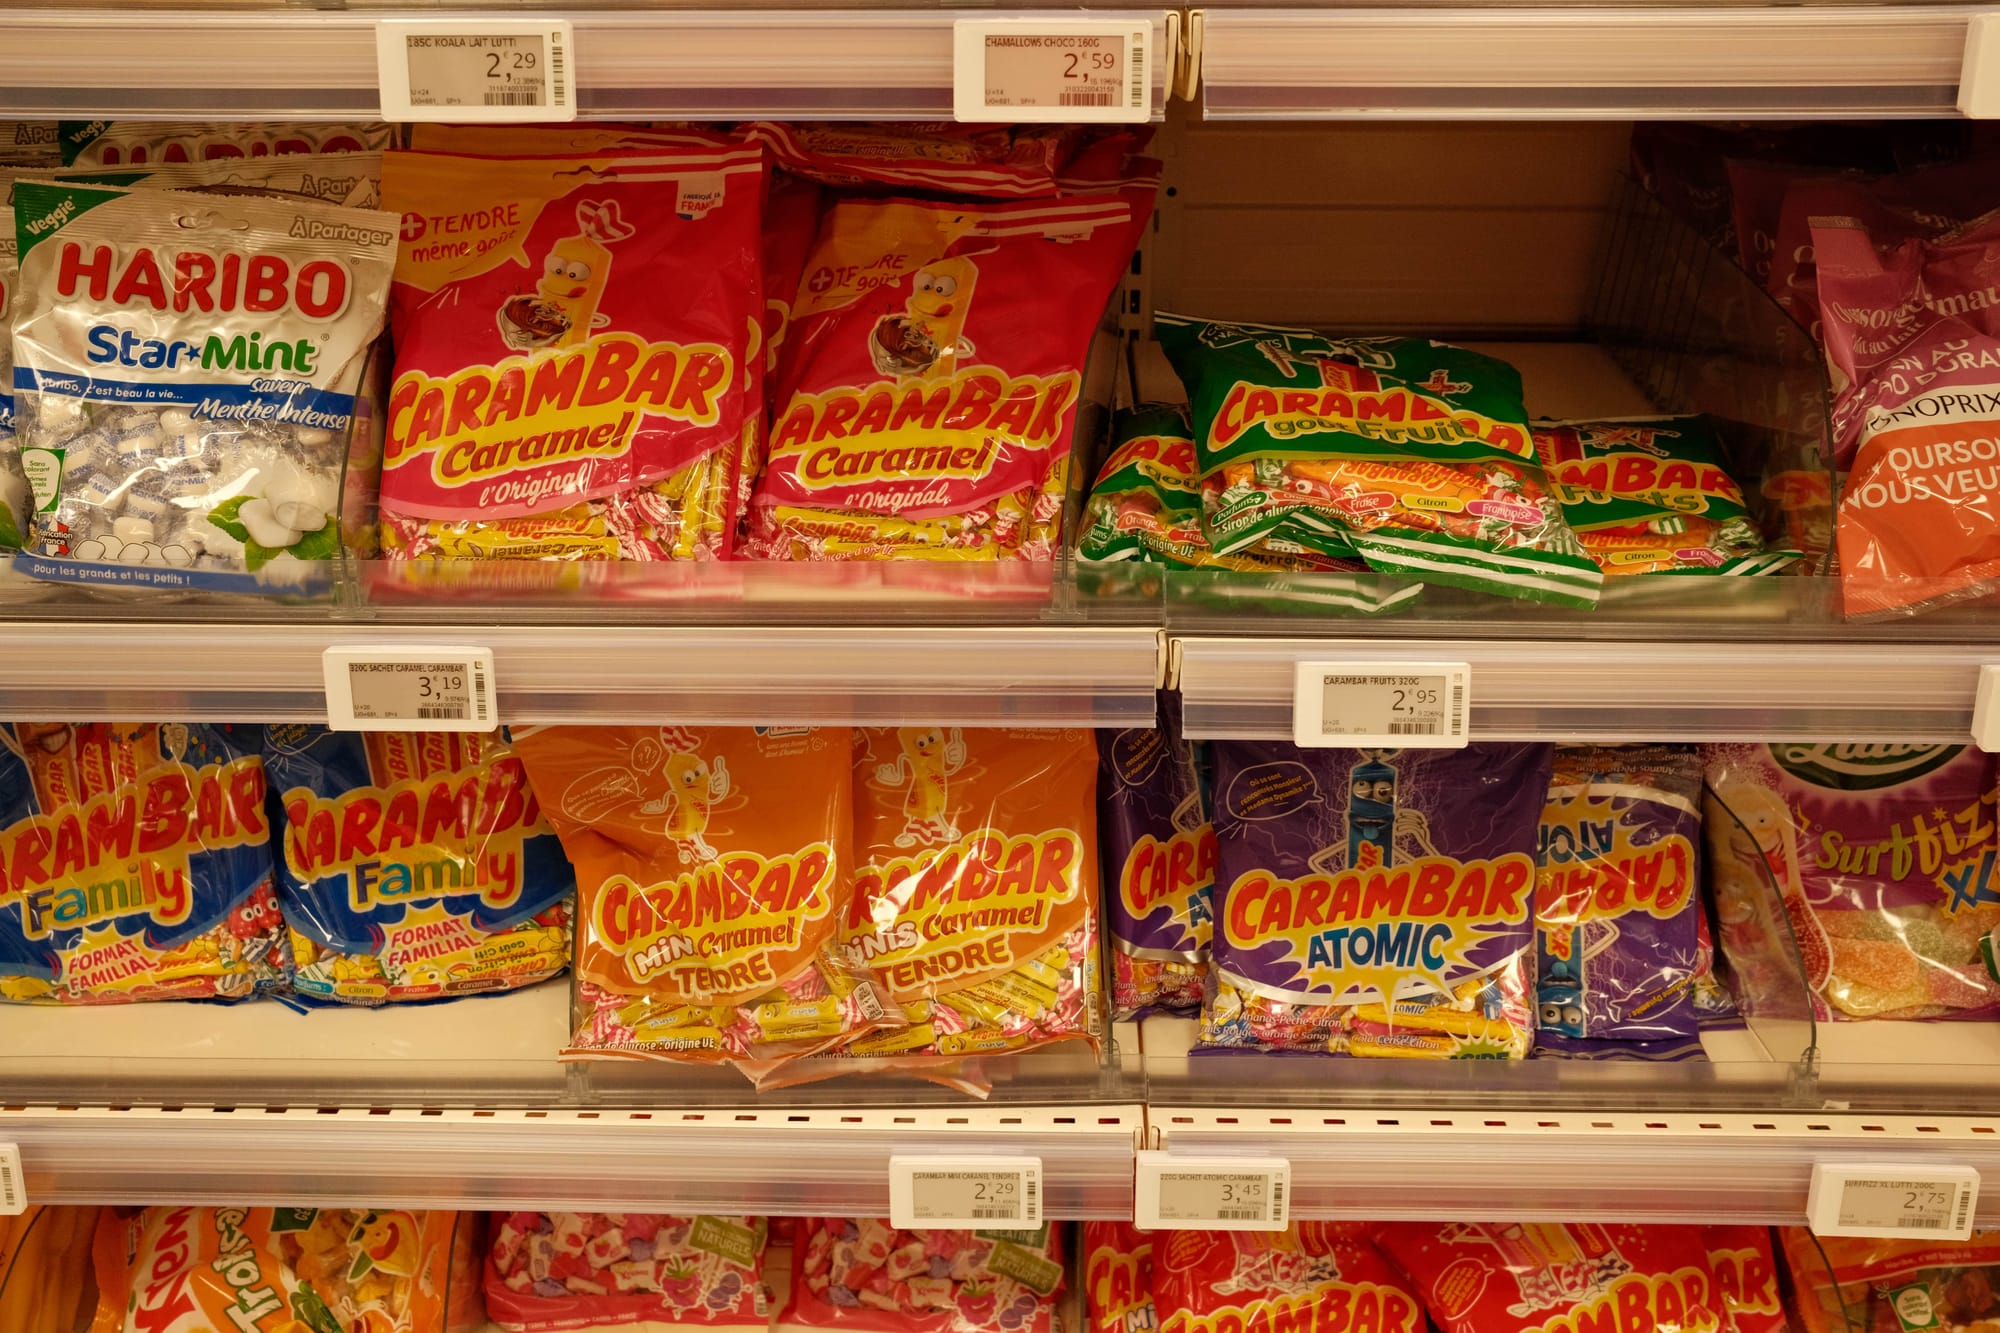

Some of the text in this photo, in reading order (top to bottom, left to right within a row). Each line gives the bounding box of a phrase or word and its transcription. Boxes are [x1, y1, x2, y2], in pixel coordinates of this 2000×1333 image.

[435, 38, 466, 48] KOALA
[469, 38, 488, 48] LAIT
[491, 38, 517, 48] LUTTI
[985, 38, 1100, 48] CHAMALLOWS CHOCO 160G
[289, 216, 393, 246] À Partager
[429, 203, 521, 235] TENDRE
[411, 240, 470, 263] même
[57, 242, 347, 319] HARIBO
[835, 254, 909, 287] TERE
[87, 325, 317, 373] Star Mint
[115, 387, 142, 398] beau
[145, 388, 155, 398] la
[386, 340, 726, 460] CARAMBAR
[197, 398, 279, 421] Menthe
[1865, 393, 2000, 432] ONOPRIX
[440, 411, 635, 478] Caramel
[1358, 420, 1478, 444] Fruit
[805, 435, 995, 481] Caramel
[478, 461, 590, 508] l'Original
[1839, 475, 1931, 513] NOUS
[1125, 517, 1158, 530] Orange
[1217, 495, 1256, 521] Parfums
[1350, 496, 1532, 521] Fraise Citron Framboise
[1624, 551, 1656, 561] Citron
[60, 566, 75, 575] les
[79, 568, 117, 579] grands
[120, 570, 132, 579] et
[135, 571, 150, 580] les
[153, 574, 183, 585] petits
[370, 664, 394, 673] SACHET
[396, 664, 426, 673] CARAMEL
[428, 664, 464, 673] CARAMBAR
[1324, 677, 1367, 685] CARAMBAR
[1370, 677, 1397, 685] FRUITS
[1267, 771, 1282, 782] sont
[0, 766, 264, 894] RAMBAR
[355, 846, 516, 904] Family
[27, 863, 186, 932] Family
[602, 850, 831, 946] CARAMBAR
[1230, 862, 1530, 941] CARAMBAR
[391, 918, 468, 948] FORMAT
[921, 899, 1043, 942] Caramel
[388, 935, 483, 967] FAMILIAL
[698, 917, 795, 959] Caramel
[1306, 921, 1455, 971] ATOMIC
[69, 938, 141, 975] FORMAT
[879, 934, 1010, 993] TENDRE
[70, 955, 162, 991] FAMILIAL
[664, 1039, 700, 1050] origine
[913, 1173, 946, 1181] CARAMBAR
[962, 1173, 990, 1181] CARAMEL
[1229, 1174, 1262, 1182] CARAMBAR
[697, 1229, 752, 1259] NATURELS
